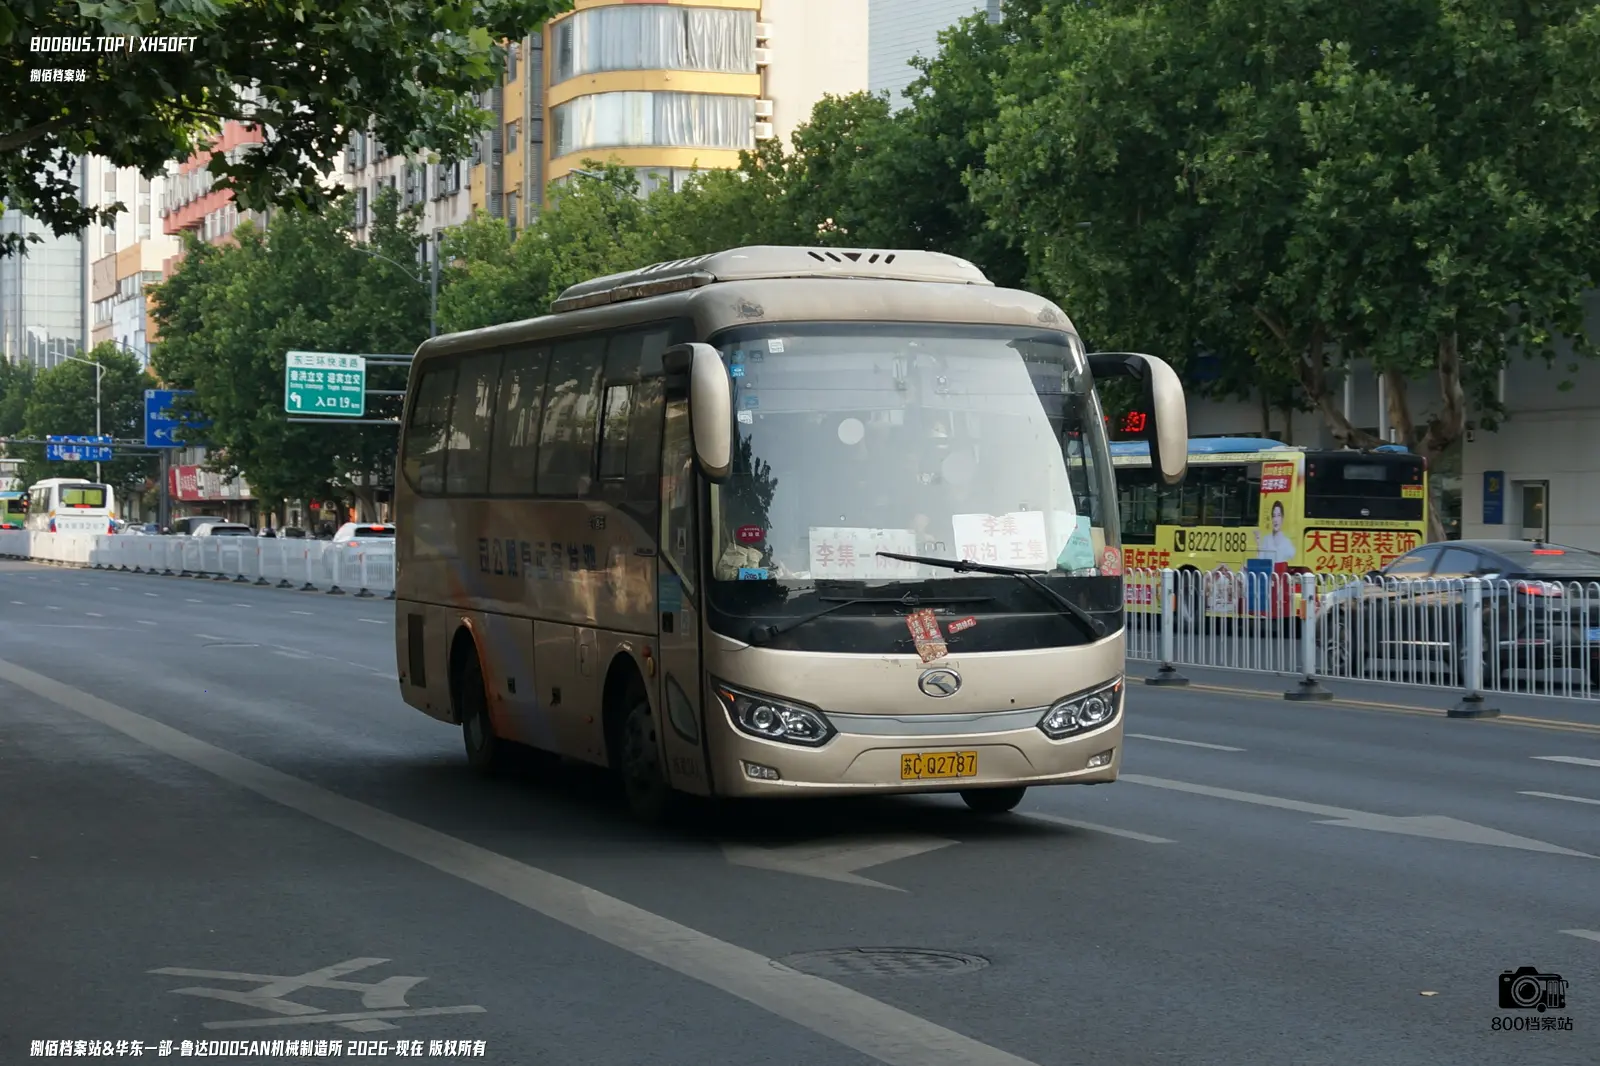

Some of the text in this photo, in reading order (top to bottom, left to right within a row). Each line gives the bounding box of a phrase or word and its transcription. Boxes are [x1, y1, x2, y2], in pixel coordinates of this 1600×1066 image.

[315, 396, 337, 408] 入口
[982, 515, 1018, 537] 李集
[961, 539, 1045, 562] 双沟 王集
[1187, 531, 1248, 552] 82221888
[1305, 531, 1416, 554] 大自然装饰
[1315, 554, 1377, 573] 24周年庆
